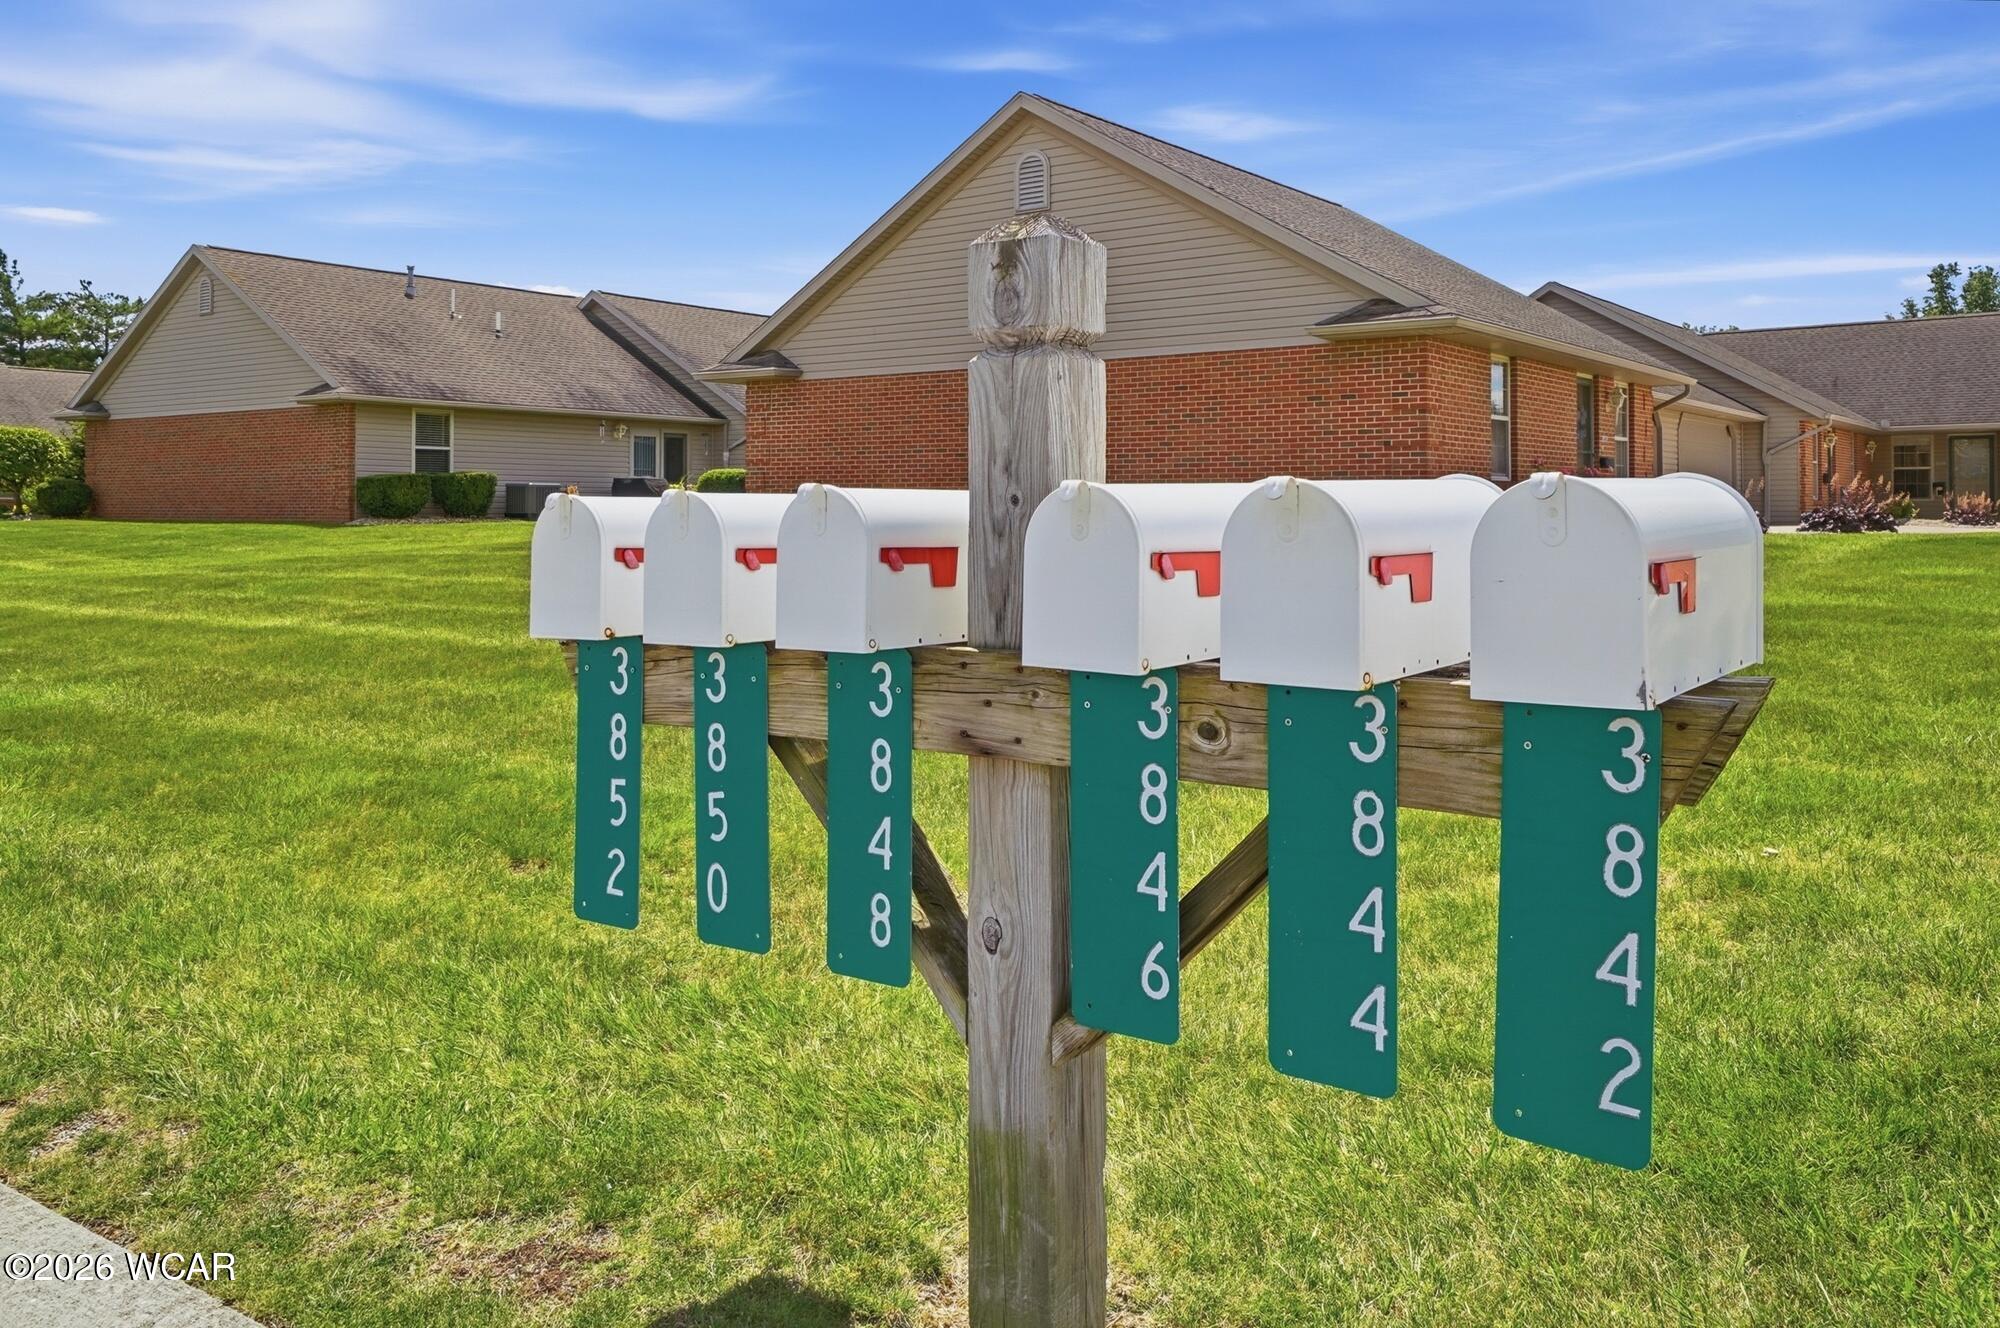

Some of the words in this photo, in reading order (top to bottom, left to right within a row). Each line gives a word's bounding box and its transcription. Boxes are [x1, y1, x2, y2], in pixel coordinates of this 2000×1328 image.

[607, 645, 629, 897] 3852
[705, 651, 728, 914] 3850
[868, 660, 894, 948] 3848
[1136, 676, 1172, 1001] 3846
[1348, 694, 1388, 1052] 3844
[1595, 717, 1645, 1118] 3842
